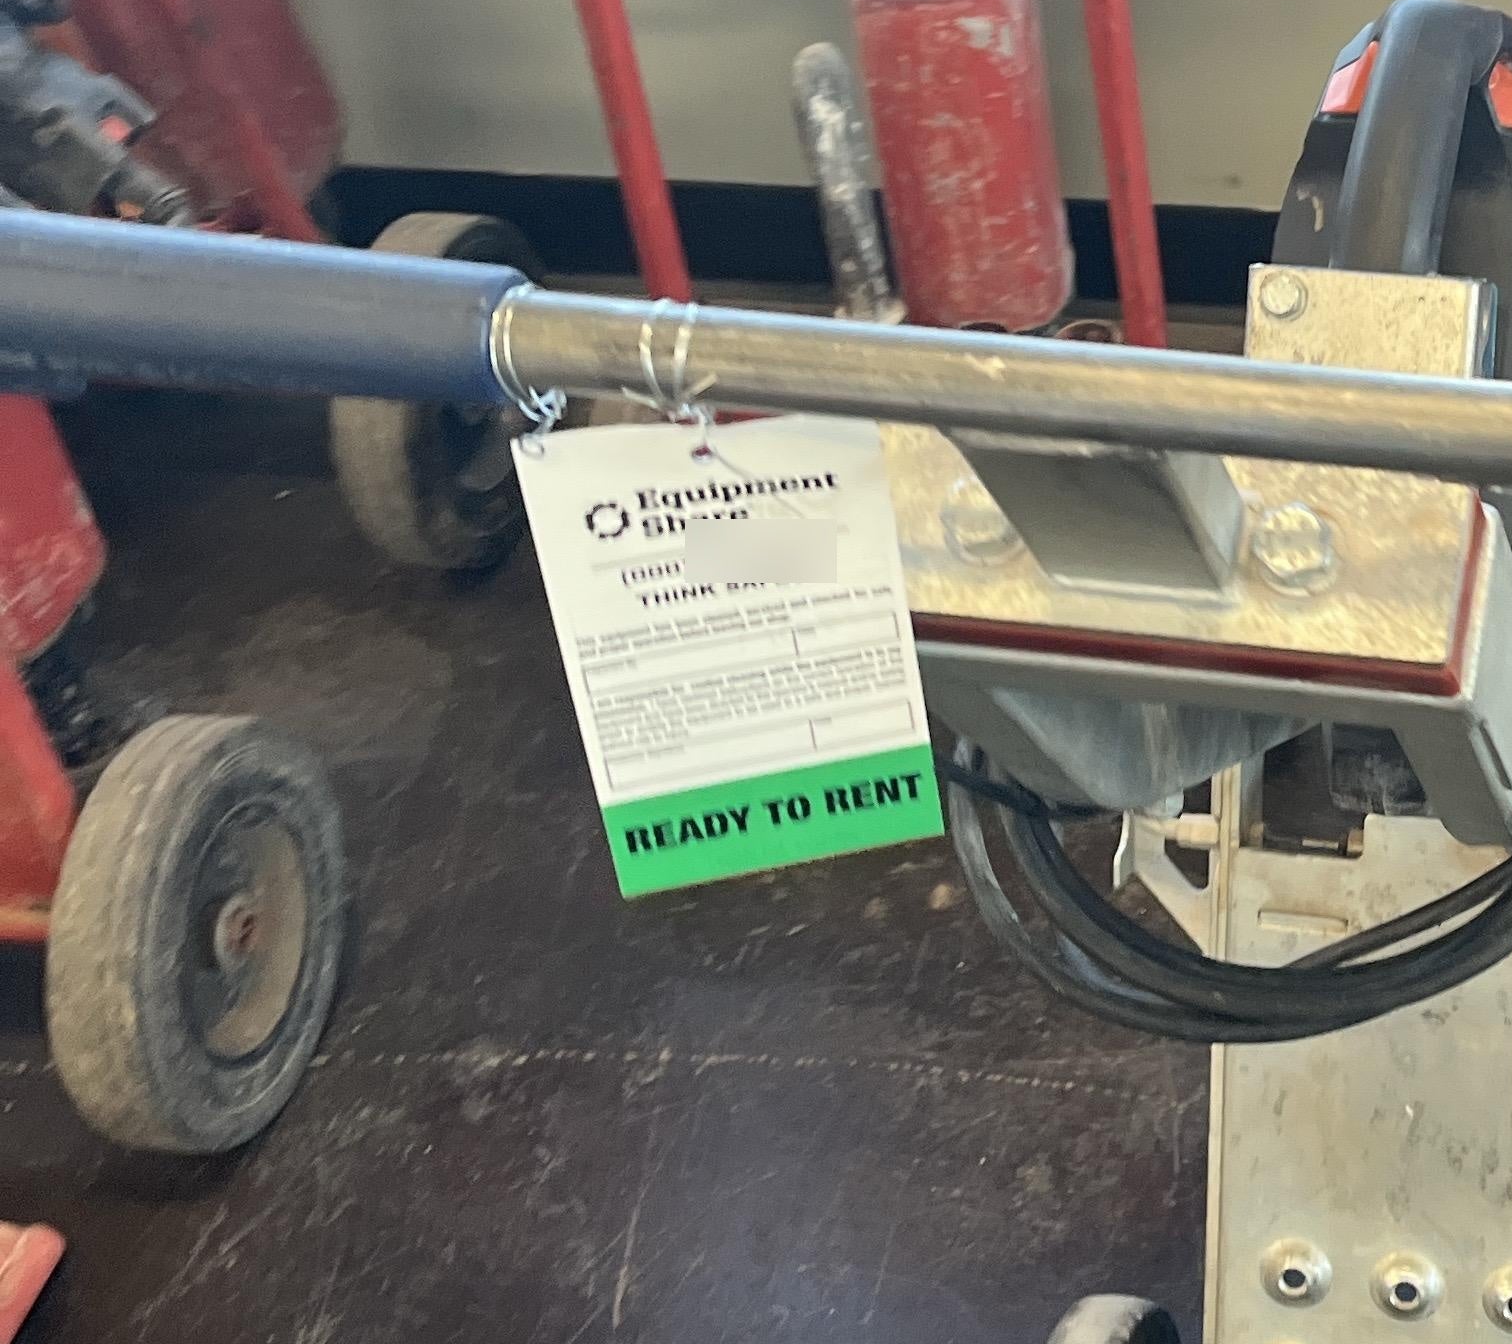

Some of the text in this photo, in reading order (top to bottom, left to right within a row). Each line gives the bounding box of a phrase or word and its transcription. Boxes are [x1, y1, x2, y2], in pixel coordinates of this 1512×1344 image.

[636, 471, 838, 510] Equipment
[636, 584, 716, 608] THINK
[624, 772, 922, 856] READY TO RENT
